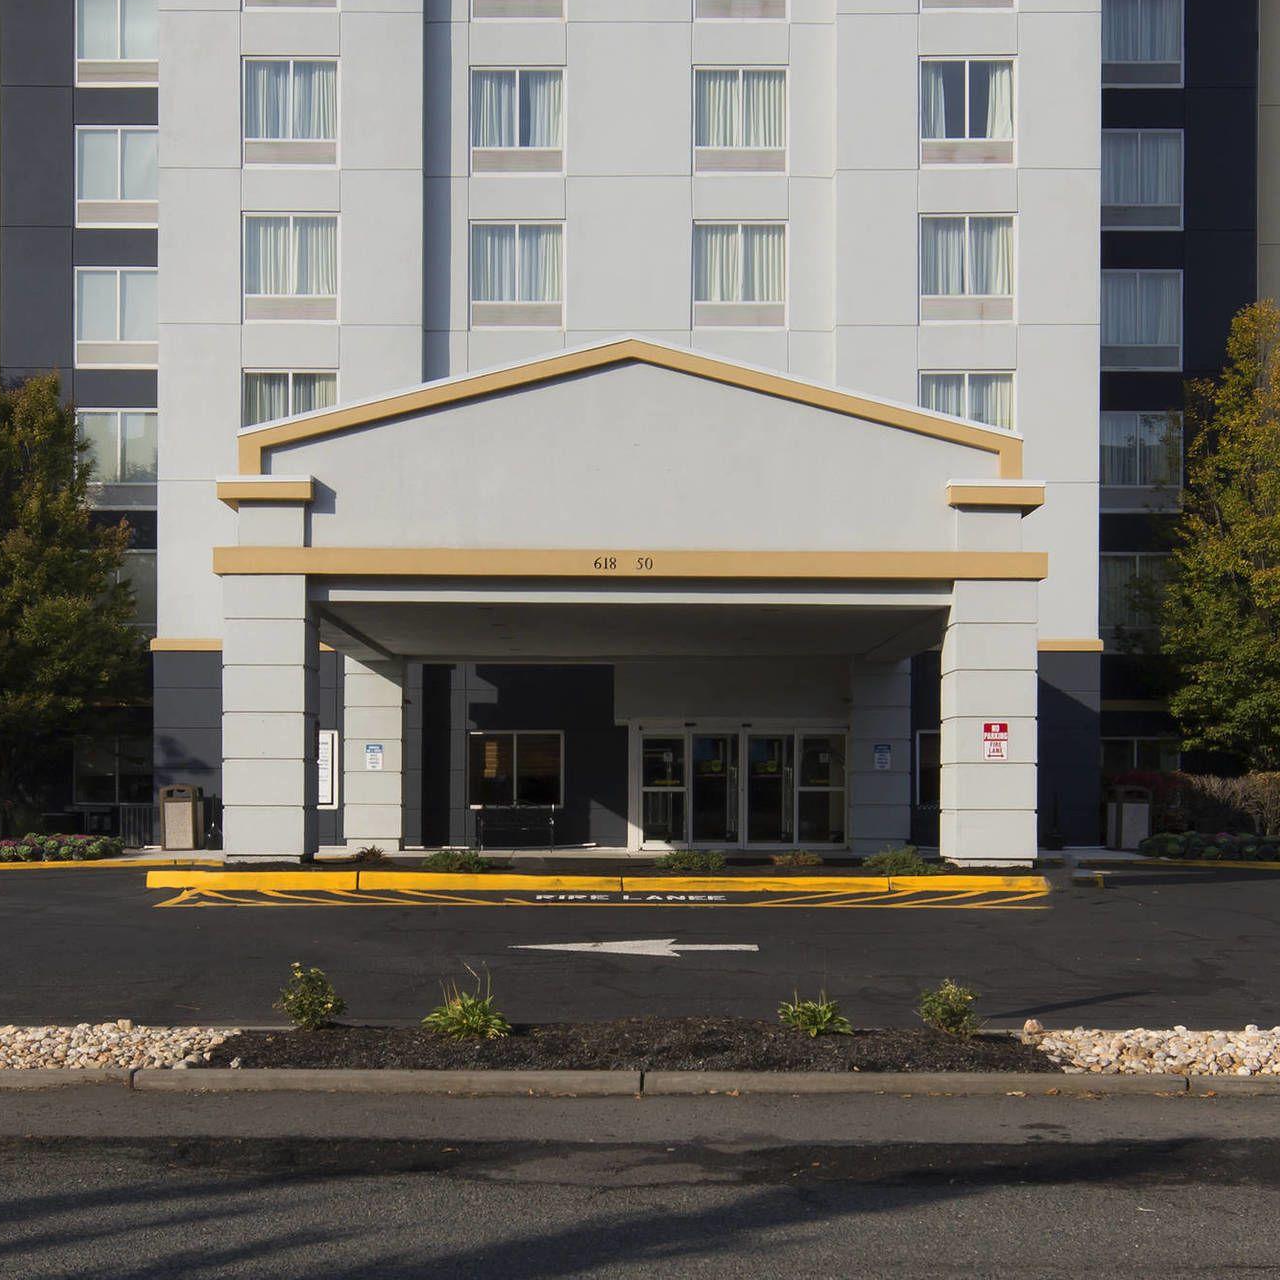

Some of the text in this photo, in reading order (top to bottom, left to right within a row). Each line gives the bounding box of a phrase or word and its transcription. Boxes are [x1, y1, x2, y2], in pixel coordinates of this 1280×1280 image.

[594, 557, 653, 570] 618 50
[983, 732, 1008, 740] PARKING
